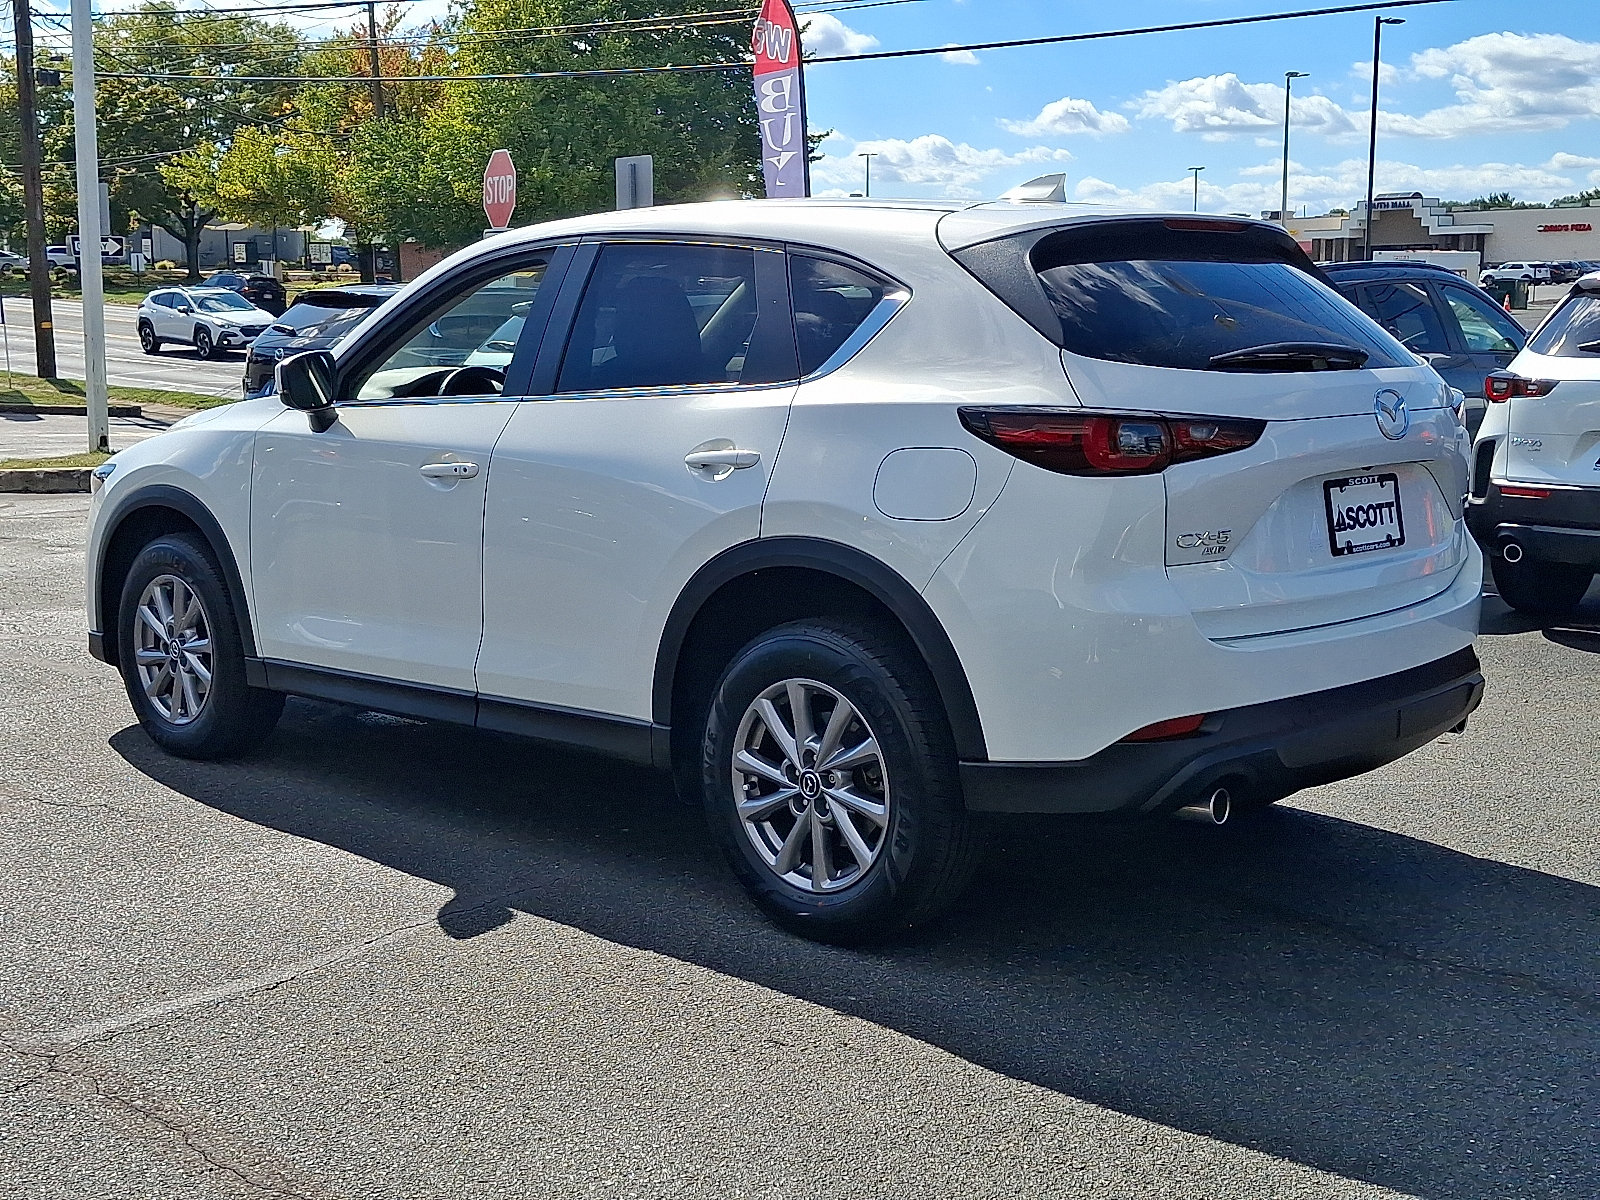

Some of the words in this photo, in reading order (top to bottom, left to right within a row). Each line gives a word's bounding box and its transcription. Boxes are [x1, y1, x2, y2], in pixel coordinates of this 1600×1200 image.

[486, 174, 514, 205] STOP
[1348, 475, 1380, 486] SCOTT
[1345, 500, 1395, 531] SCOTT
[1176, 529, 1232, 549] CX-5
[1352, 541, 1391, 553] scottcars.com
